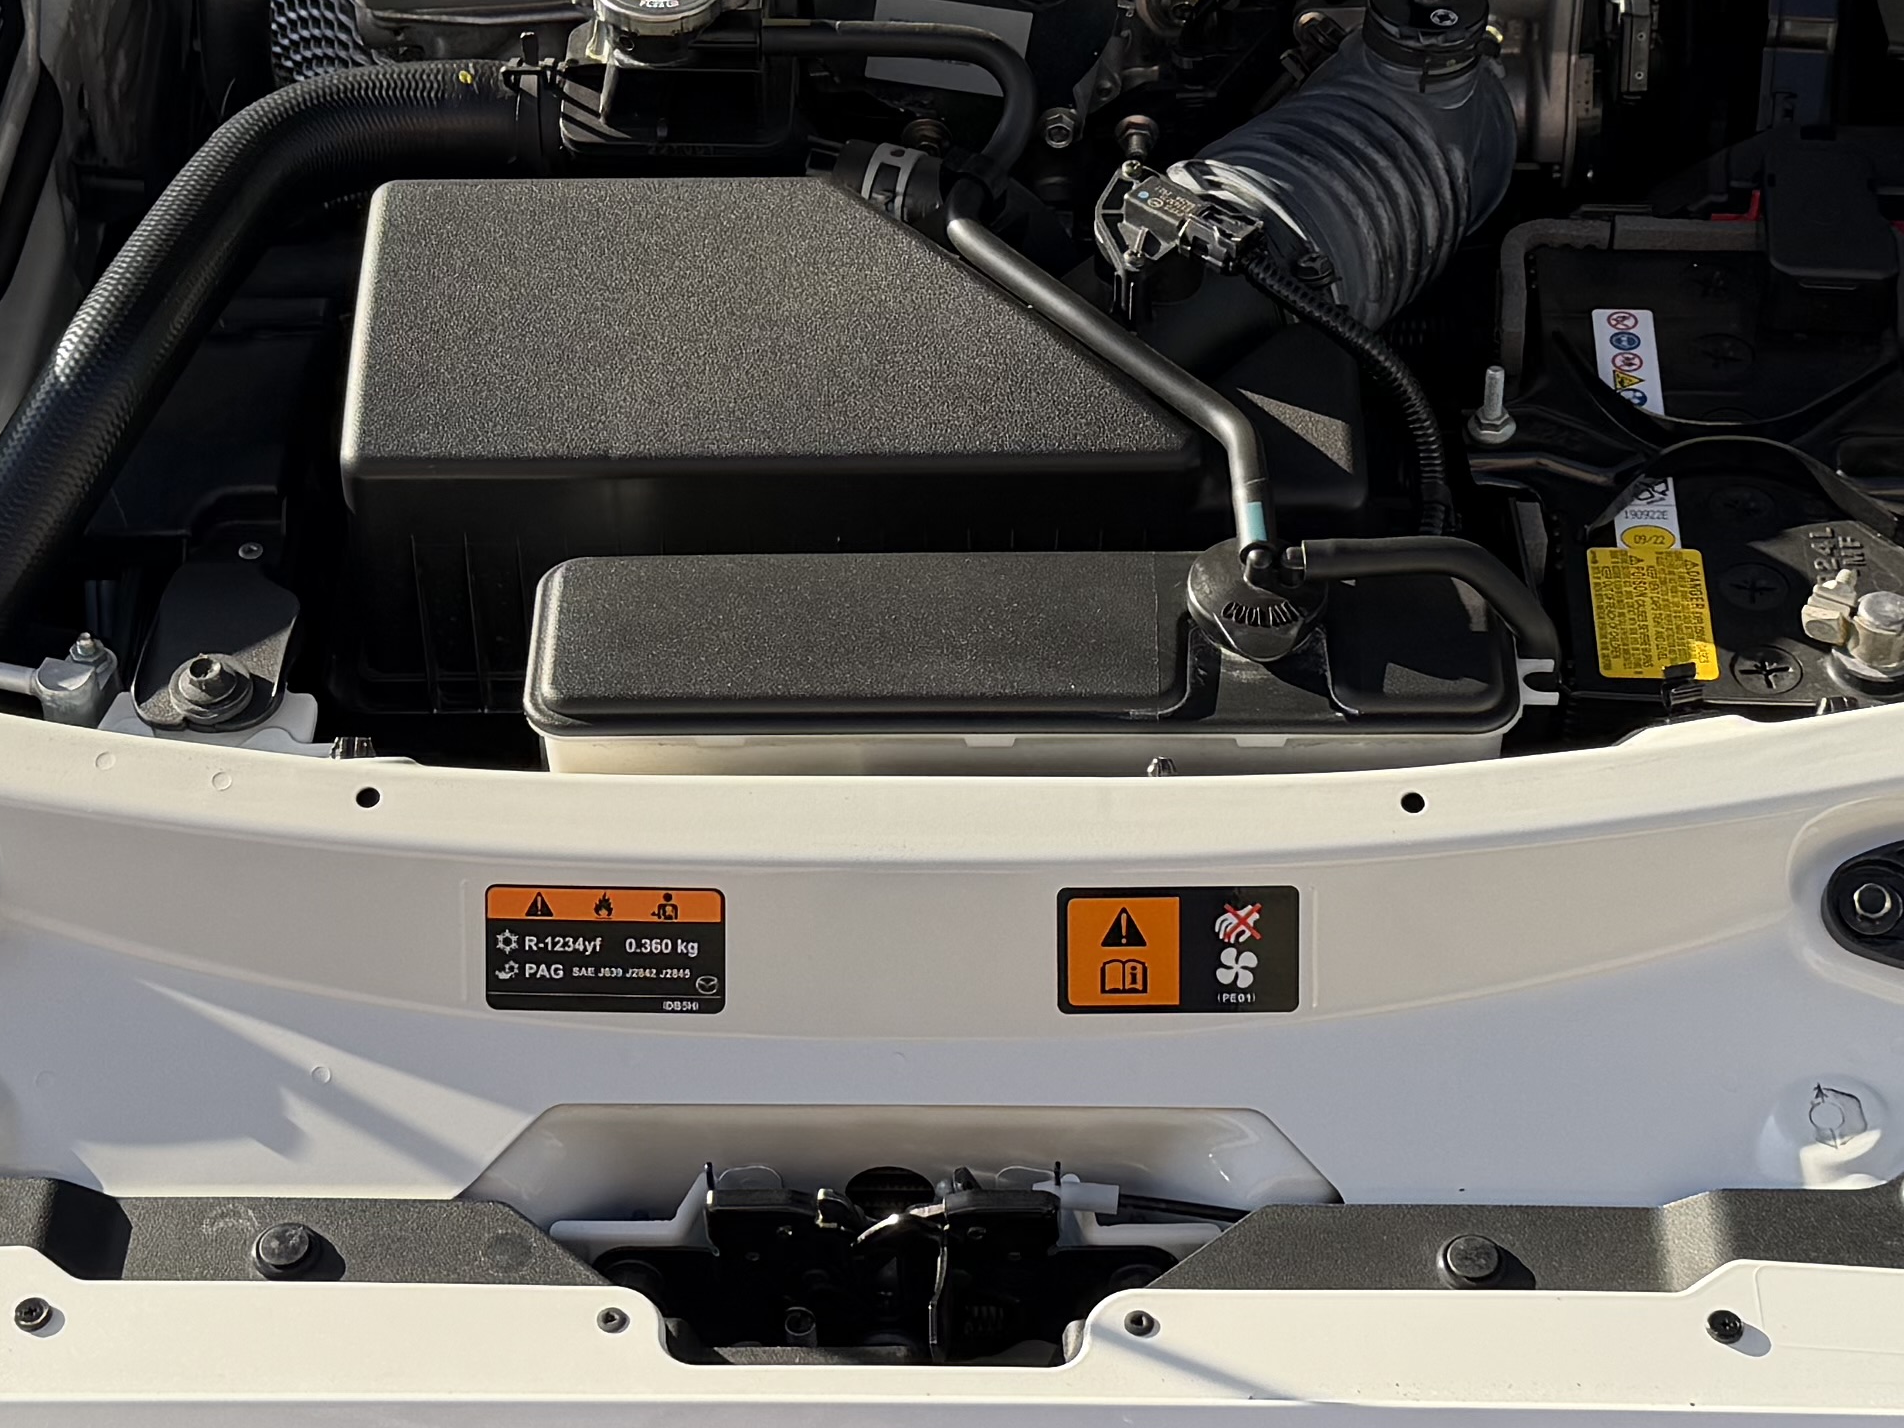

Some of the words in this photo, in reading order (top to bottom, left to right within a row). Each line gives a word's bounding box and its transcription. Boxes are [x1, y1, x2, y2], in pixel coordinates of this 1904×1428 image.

[1634, 534, 1666, 545] 09/22
[1687, 571, 1705, 610] DANGER
[1220, 600, 1302, 628] COOLANT
[524, 936, 602, 955] R-1234yf
[625, 938, 672, 953] 0.360
[677, 938, 699, 957] kg
[525, 963, 564, 979] PAG
[572, 967, 596, 977] SAE
[1217, 992, 1256, 1003] (PE01)
